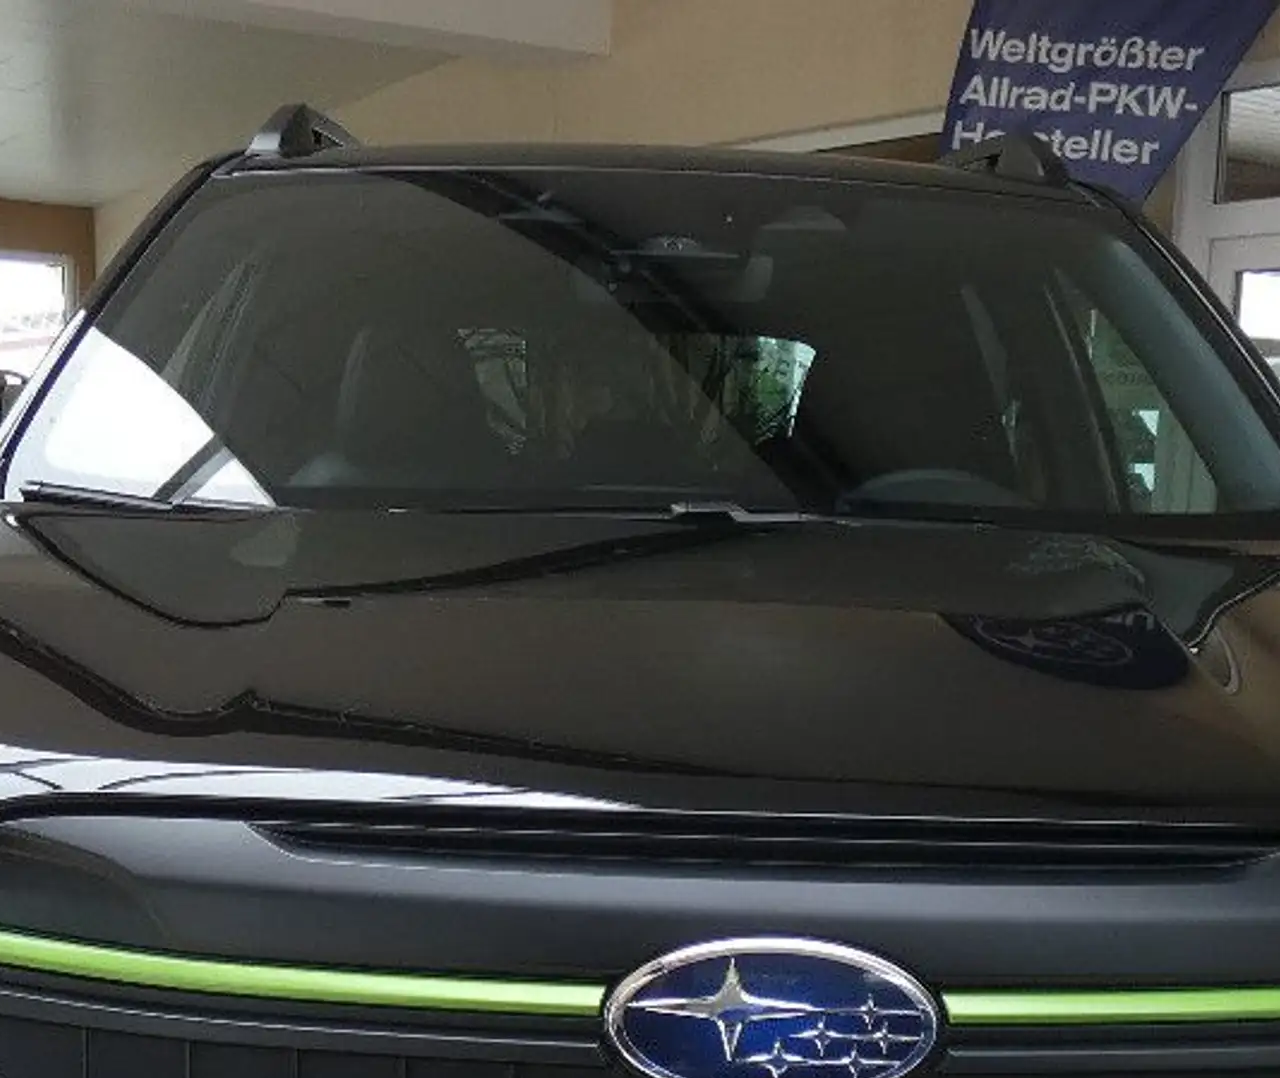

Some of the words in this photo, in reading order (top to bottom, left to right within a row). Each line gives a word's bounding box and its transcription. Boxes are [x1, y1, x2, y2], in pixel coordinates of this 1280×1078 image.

[970, 28, 1205, 74] Weltgrößter
[959, 74, 1198, 119] Allrad-PKW-
[951, 120, 1160, 165] Hteller
